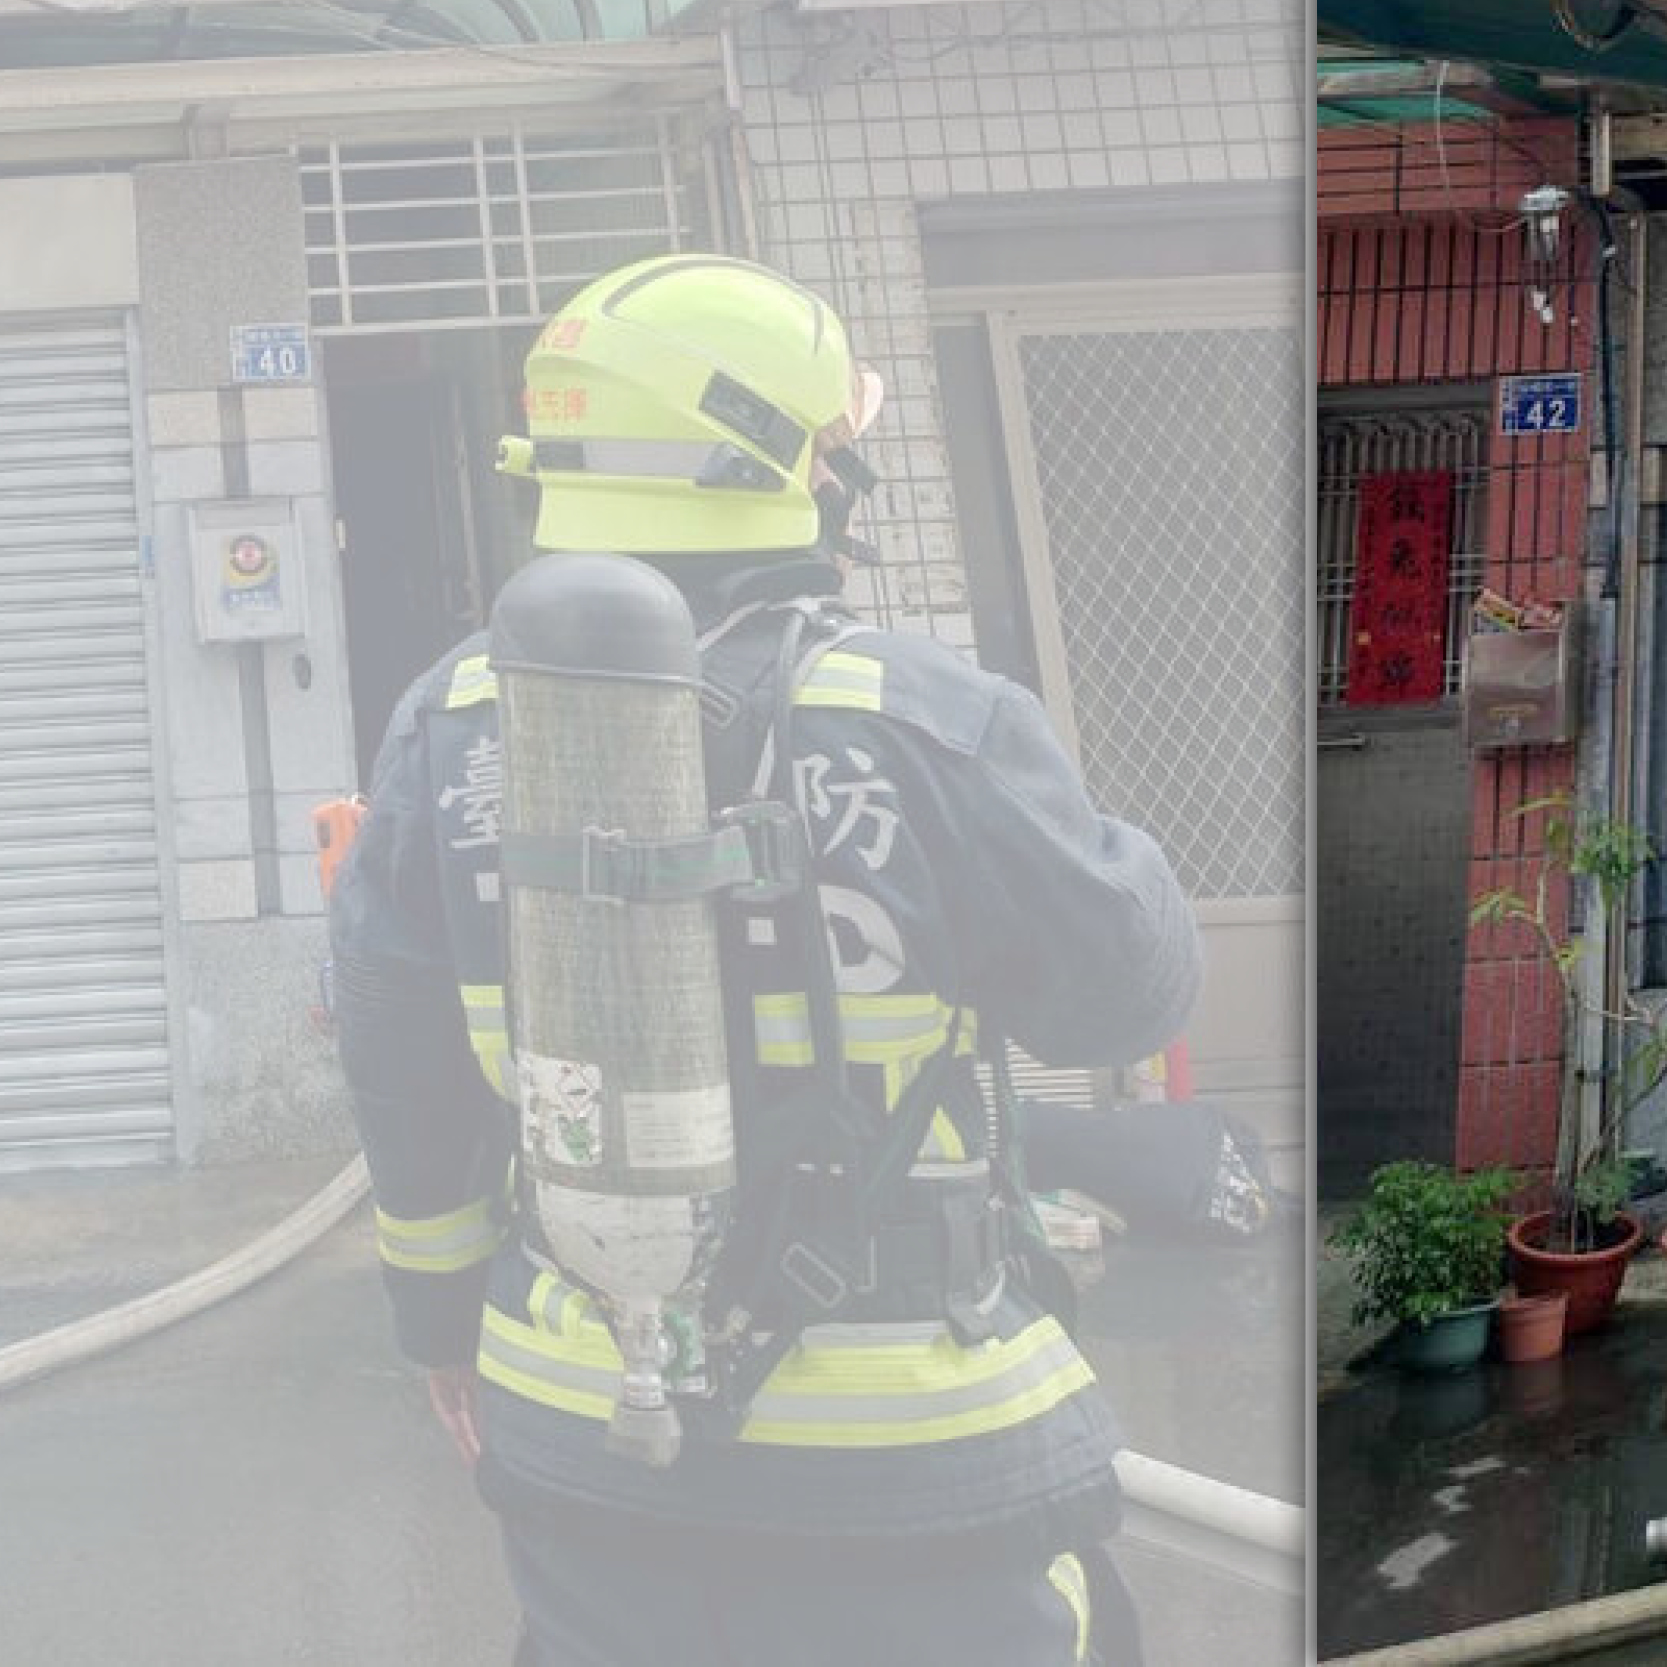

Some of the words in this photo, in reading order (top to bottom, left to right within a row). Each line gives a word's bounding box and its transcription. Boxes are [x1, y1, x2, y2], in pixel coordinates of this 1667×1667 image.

[260, 346, 297, 376] 40
[1526, 400, 1566, 430] 42
[792, 747, 900, 871] 防
